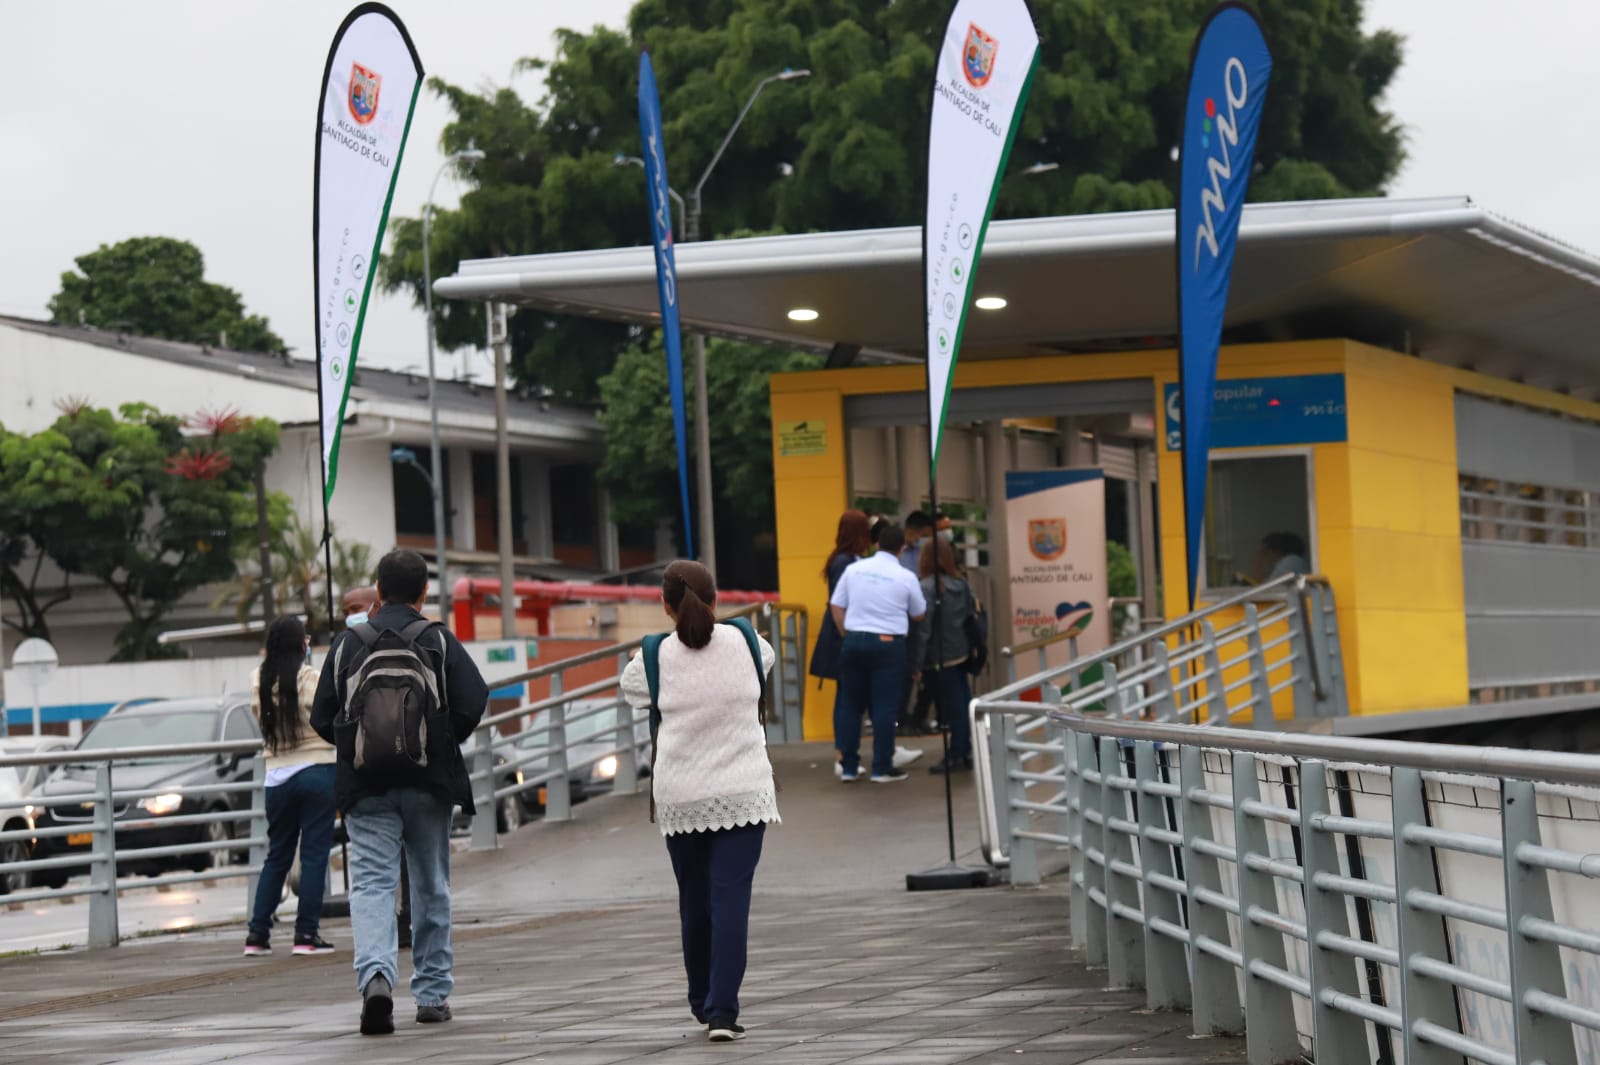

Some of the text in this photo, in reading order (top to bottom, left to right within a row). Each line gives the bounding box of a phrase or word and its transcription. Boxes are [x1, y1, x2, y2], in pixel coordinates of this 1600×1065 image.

[981, 101, 991, 113] DE
[973, 109, 984, 125] DE
[985, 118, 1002, 137] CALI
[369, 134, 378, 148] DE
[360, 144, 371, 159] DE
[372, 151, 390, 168] CALI
[1214, 384, 1263, 404] opular
[1056, 573, 1068, 583] DE
[1072, 572, 1093, 582] CALI
